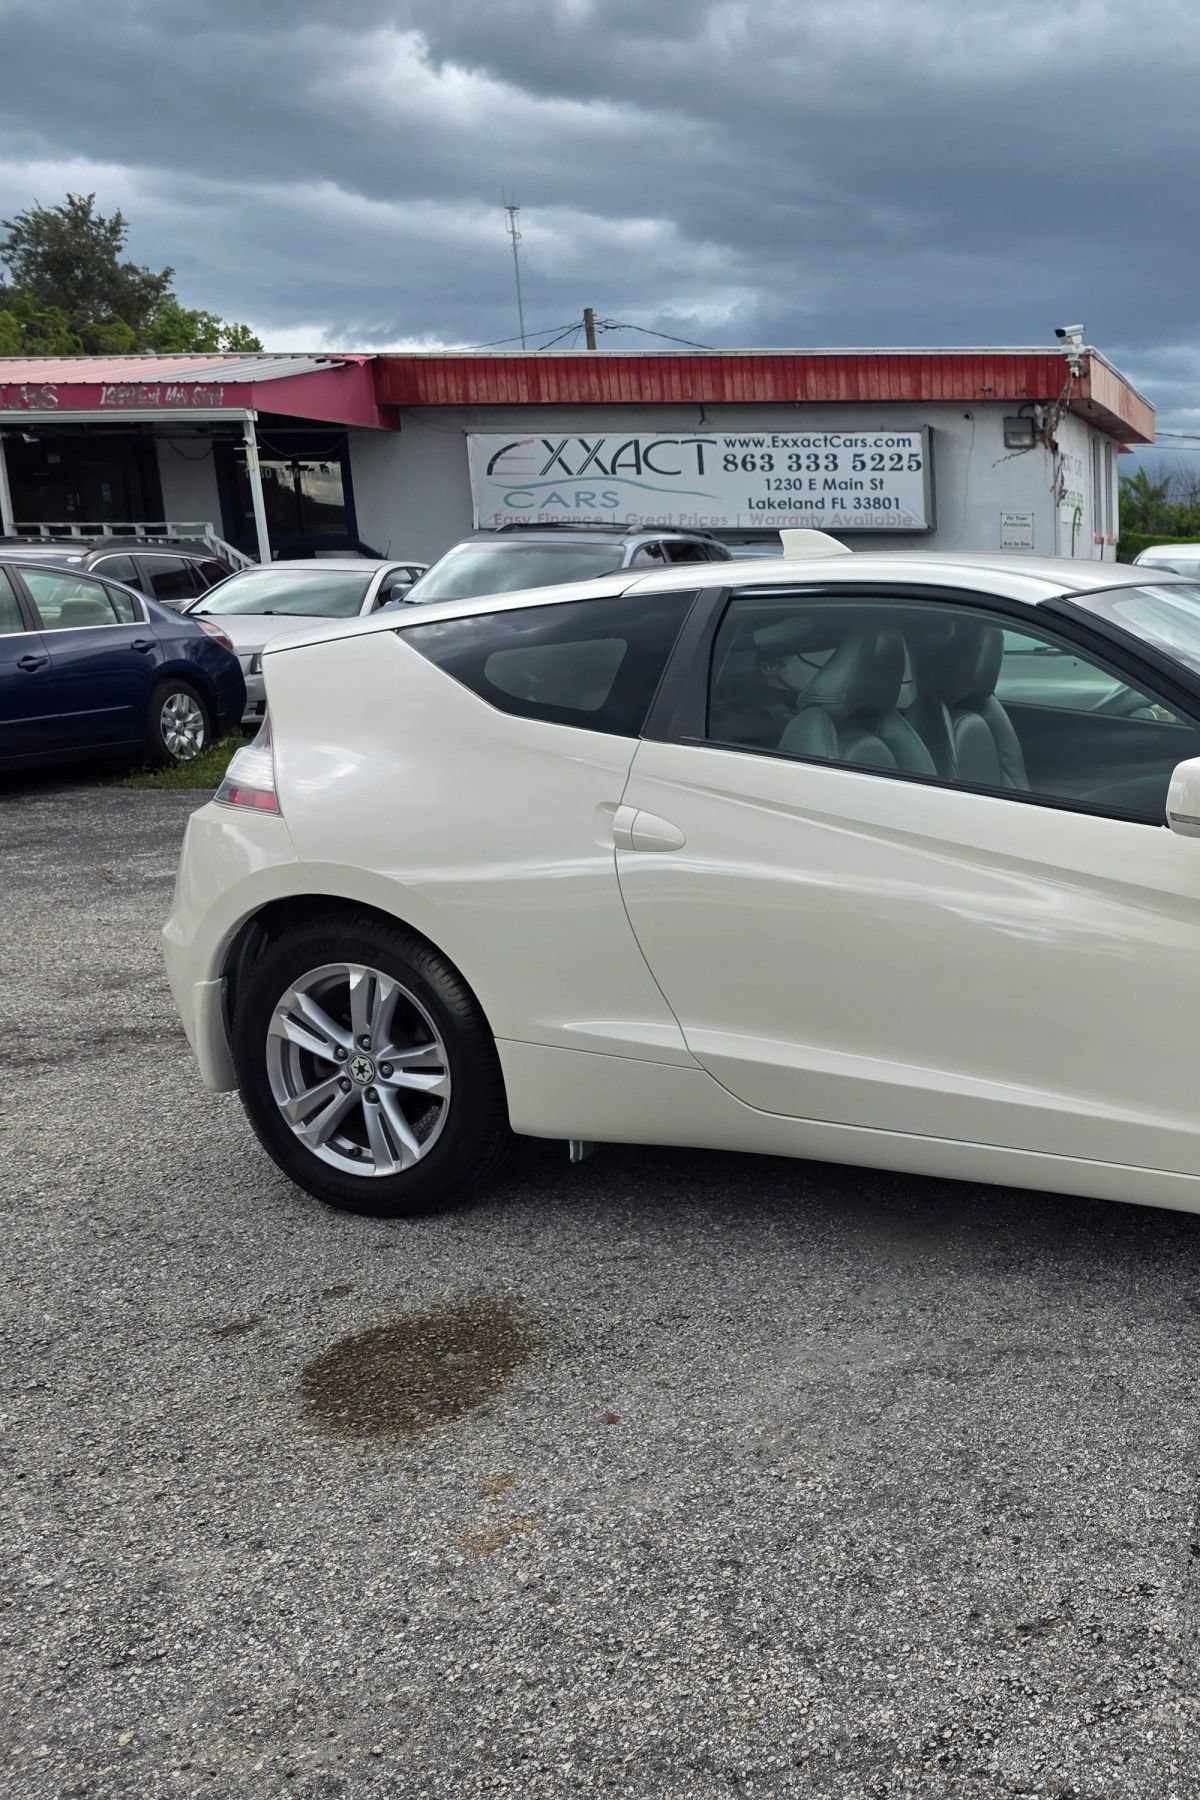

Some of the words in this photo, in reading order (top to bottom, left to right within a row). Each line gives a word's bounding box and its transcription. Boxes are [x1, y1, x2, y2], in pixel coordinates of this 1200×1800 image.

[723, 435, 912, 449] www.ExxactCars.com
[486, 438, 718, 476] EXXACT
[722, 453, 775, 473] 863
[787, 453, 839, 473] 333
[851, 453, 922, 472] 5225
[764, 478, 803, 491] 1230
[808, 478, 817, 491] E
[822, 478, 864, 491] Main
[870, 478, 885, 491] St
[503, 491, 621, 509] CARS
[748, 497, 825, 510] Lakeland
[831, 497, 847, 510] FL
[853, 497, 900, 509] 33801
[680, 512, 729, 526] Prices
[750, 514, 825, 529] Warranty
[831, 512, 913, 527] Available
